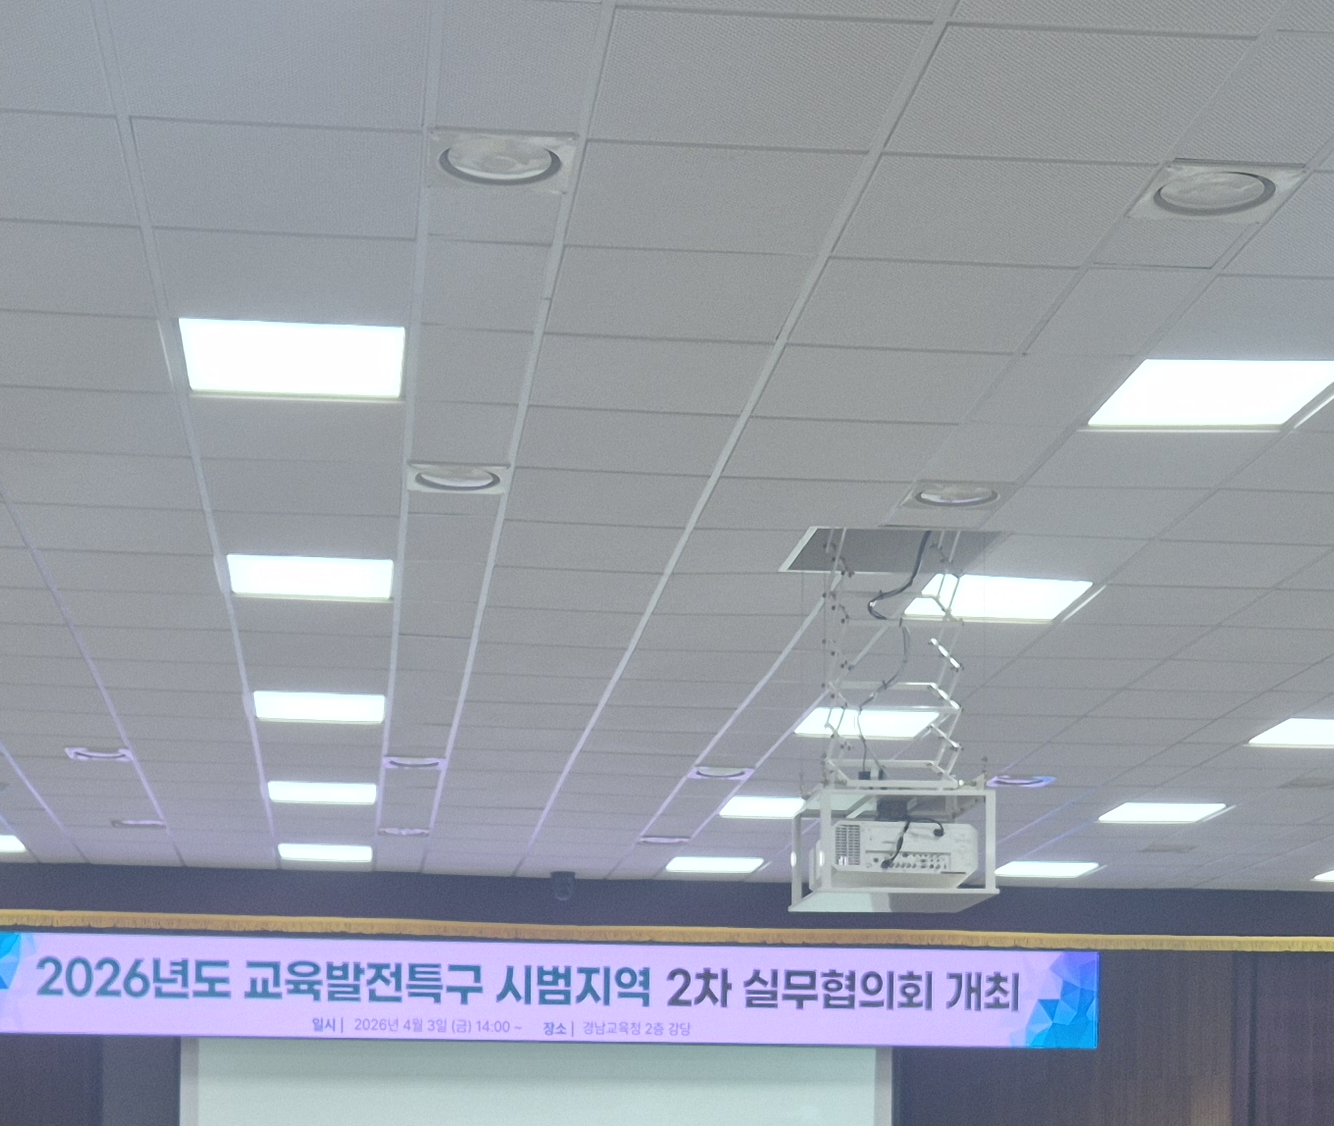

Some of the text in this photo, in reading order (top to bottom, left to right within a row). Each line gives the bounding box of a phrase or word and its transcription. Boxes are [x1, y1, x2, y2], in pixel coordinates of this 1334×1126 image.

[35, 955, 1020, 1012] 2026년도 교육발전특구 시범지역 2차 실무협의회 개최
[312, 1017, 336, 1032] 일시
[354, 1017, 400, 1032] 2026년
[403, 1018, 423, 1033] 4월
[427, 1018, 447, 1033] 3일
[475, 1020, 511, 1033] 14:00
[543, 1021, 691, 1036] 장소 경남교육청 2층 강당
